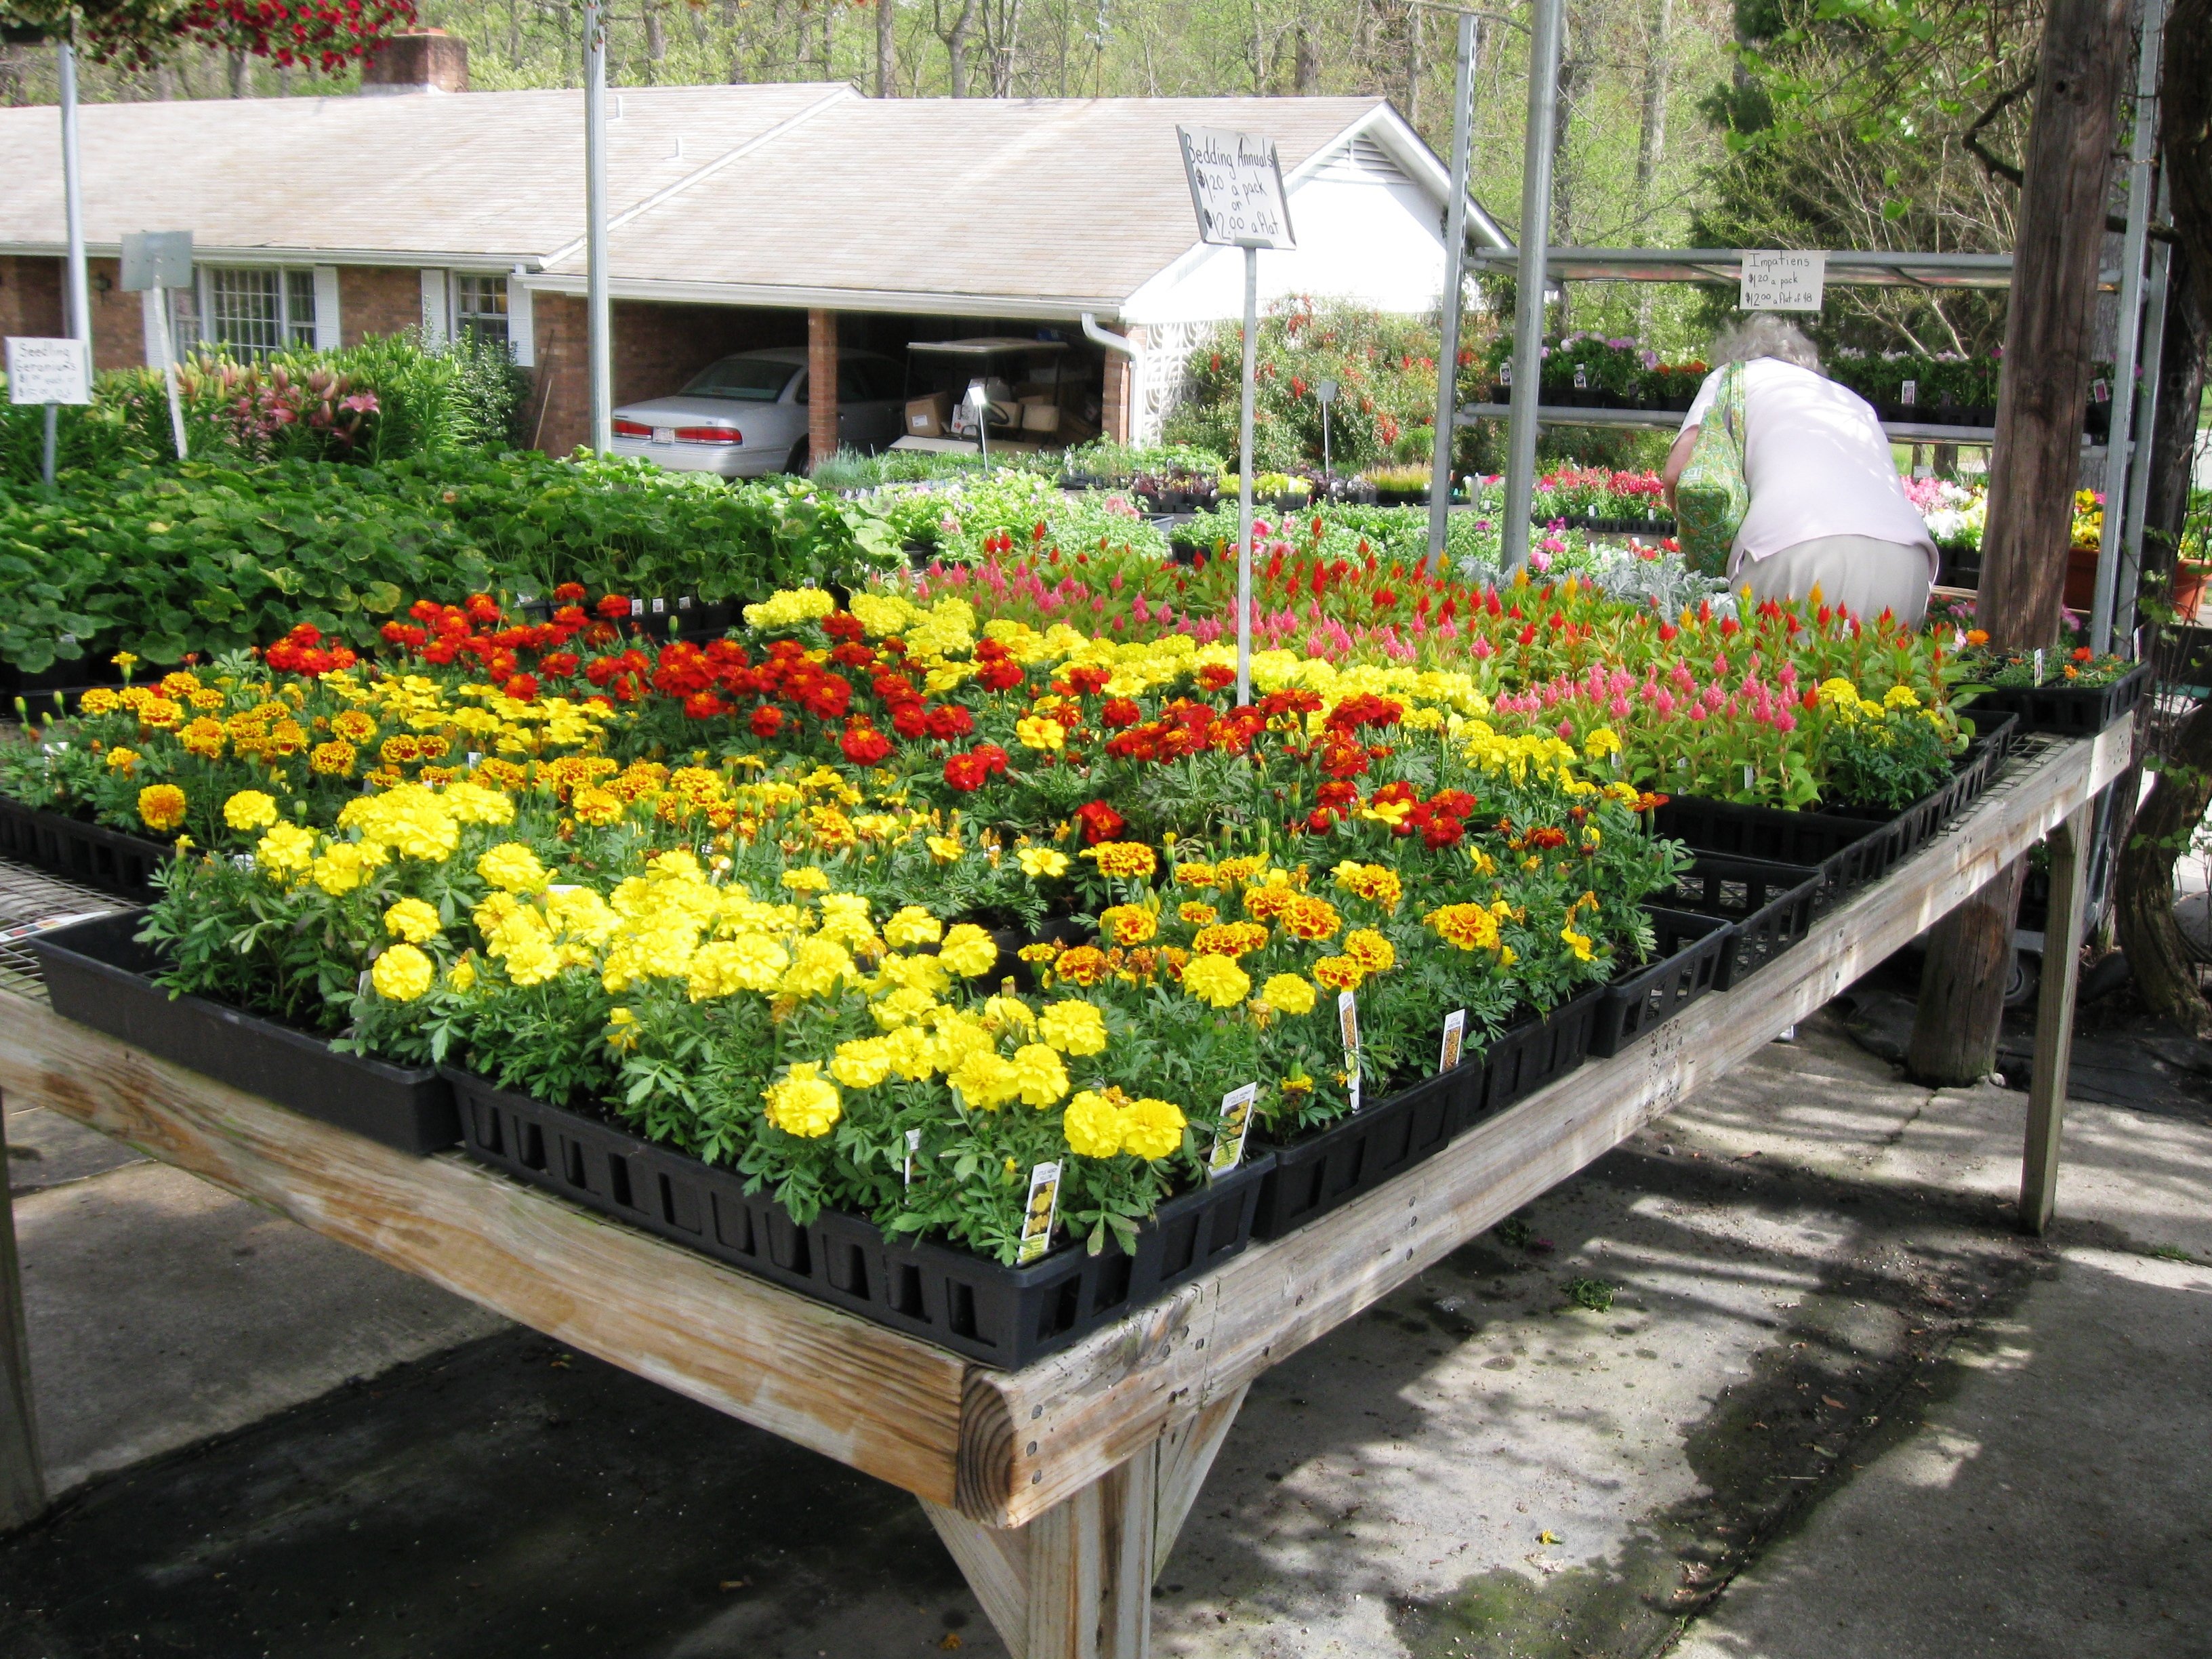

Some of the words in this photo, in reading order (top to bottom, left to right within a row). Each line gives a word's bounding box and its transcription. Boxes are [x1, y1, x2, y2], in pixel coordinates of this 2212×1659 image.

[1185, 133, 1237, 180] Bedding
[1237, 137, 1273, 167] Annuals
[1231, 184, 1240, 196] a
[1242, 170, 1267, 205] pack
[1231, 200, 1242, 211] or
[1257, 209, 1279, 234] flat
[1748, 250, 1810, 272] Impatiens
[1780, 271, 1798, 289] pack
[1803, 292, 1812, 304] 48
